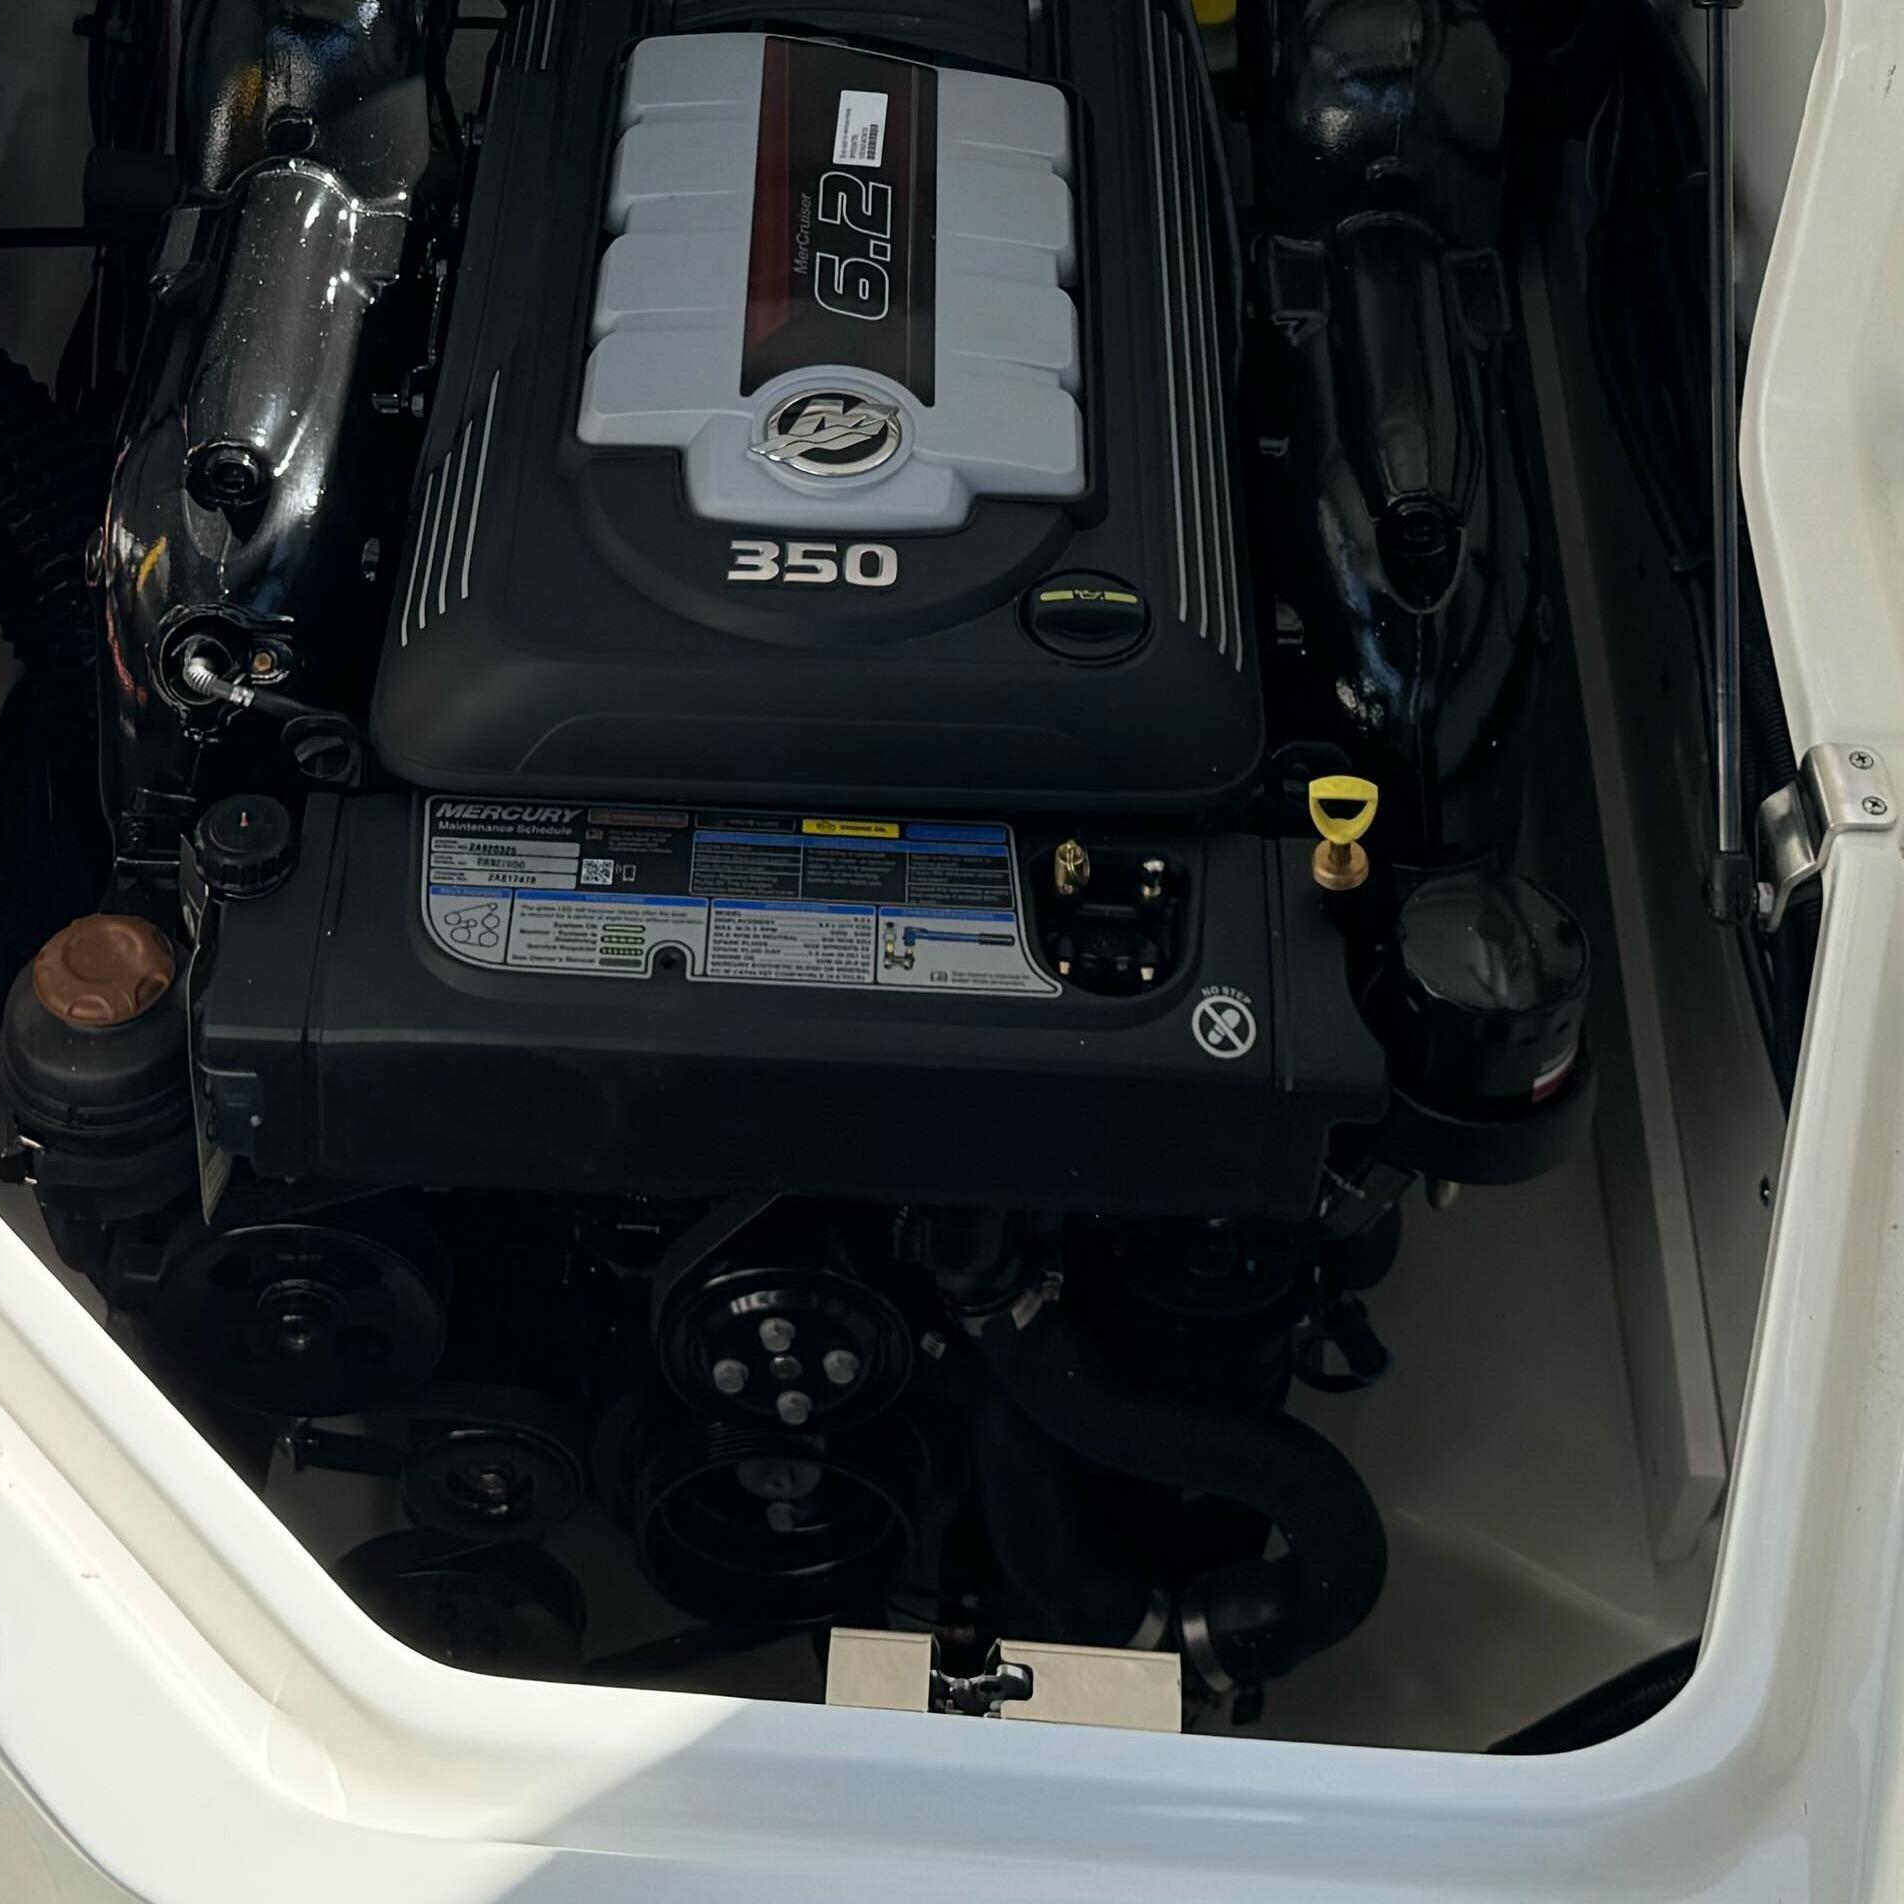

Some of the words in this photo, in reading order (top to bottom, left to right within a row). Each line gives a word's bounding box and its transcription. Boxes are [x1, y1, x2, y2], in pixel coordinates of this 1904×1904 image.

[794, 193, 813, 276] MerCruiser
[814, 170, 892, 321] 6.2
[726, 538, 898, 589] 350
[436, 802, 584, 823] MERCURY
[438, 822, 513, 835] Maintenance
[516, 825, 572, 838] Schedule
[1201, 985, 1219, 997] NO
[1222, 985, 1253, 1004] STEP
